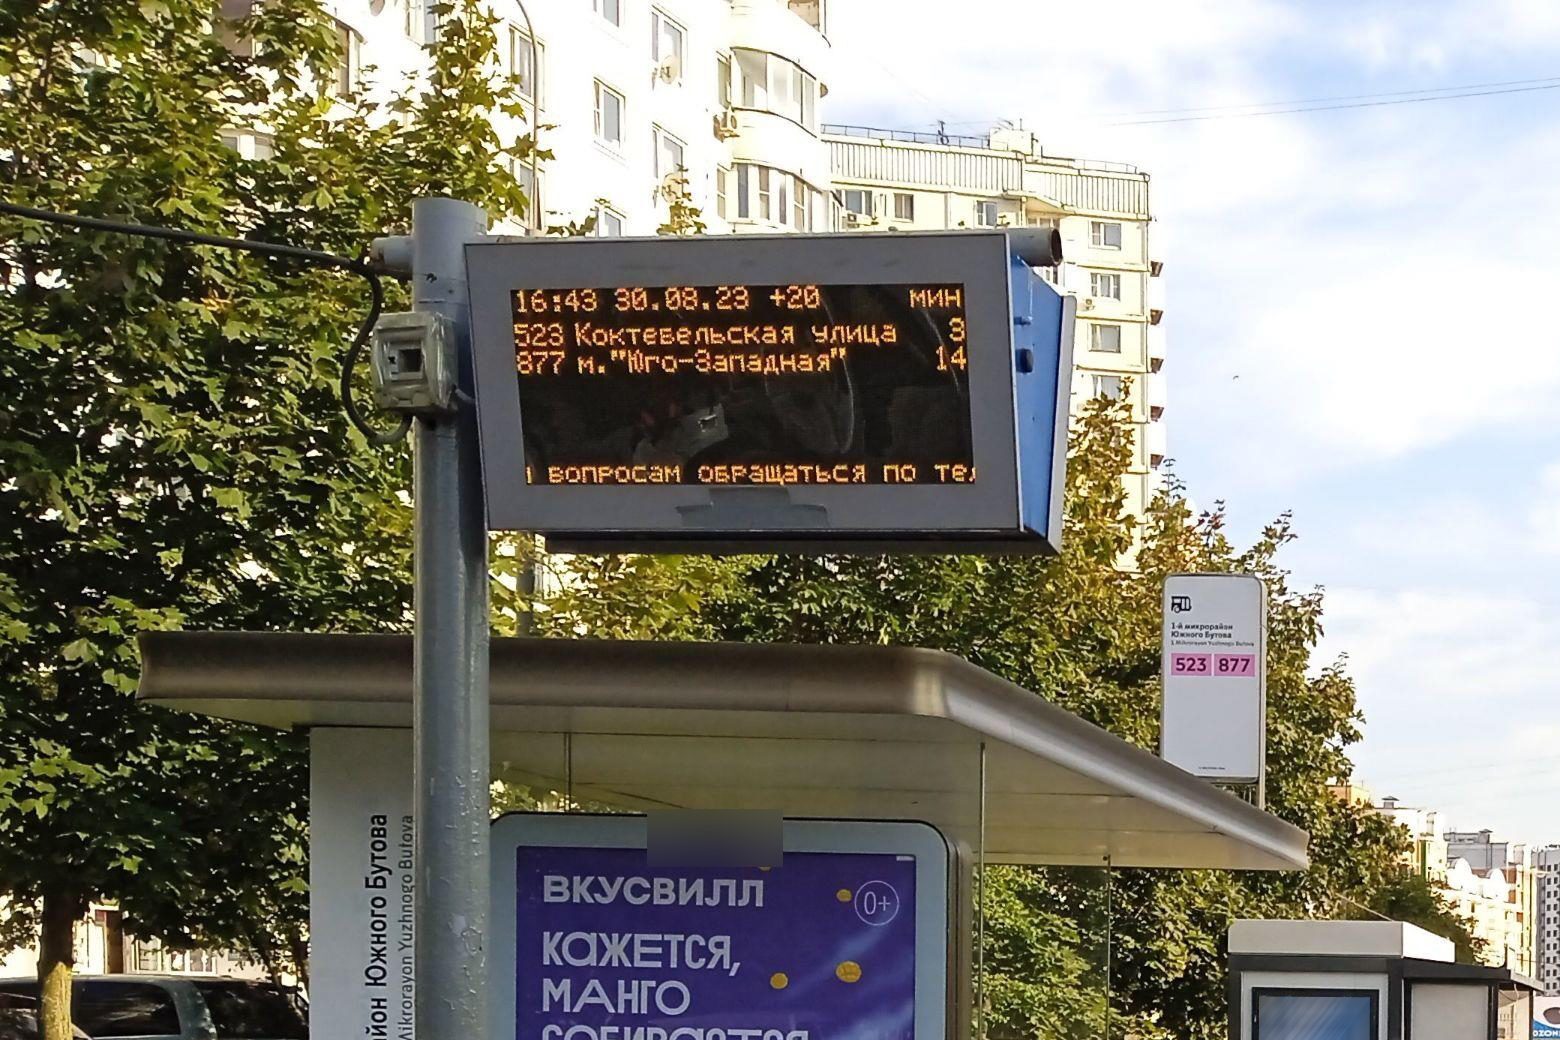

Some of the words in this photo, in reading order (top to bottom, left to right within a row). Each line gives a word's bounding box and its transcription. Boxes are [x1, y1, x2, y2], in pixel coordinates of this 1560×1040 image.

[516, 288, 598, 313] 16:43
[614, 286, 750, 311] 30.08.23
[769, 285, 820, 310] +20
[513, 322, 565, 347] 523
[811, 324, 897, 347] улица
[948, 316, 965, 342] 3
[516, 350, 565, 375] 877
[577, 354, 606, 374] м.
[609, 347, 847, 376] "Юго-Западная"
[936, 345, 967, 371] 14
[547, 464, 681, 484] вопросам
[698, 463, 866, 486] обращаться
[882, 463, 916, 483] по
[1171, 630, 1204, 638] Южного
[1204, 630, 1232, 640] Бутова
[1184, 622, 1233, 631] микрорайон
[1175, 657, 1207, 672] 523
[1218, 657, 1251, 673] 877
[364, 813, 393, 889] Бутова
[397, 814, 414, 872] Butova
[543, 875, 764, 908] ВКУСВИЛЛ
[863, 890, 891, 915] 0+
[397, 873, 416, 950] Yuzhnogo
[364, 896, 389, 988] Южного
[542, 977, 691, 1016] МАНГО
